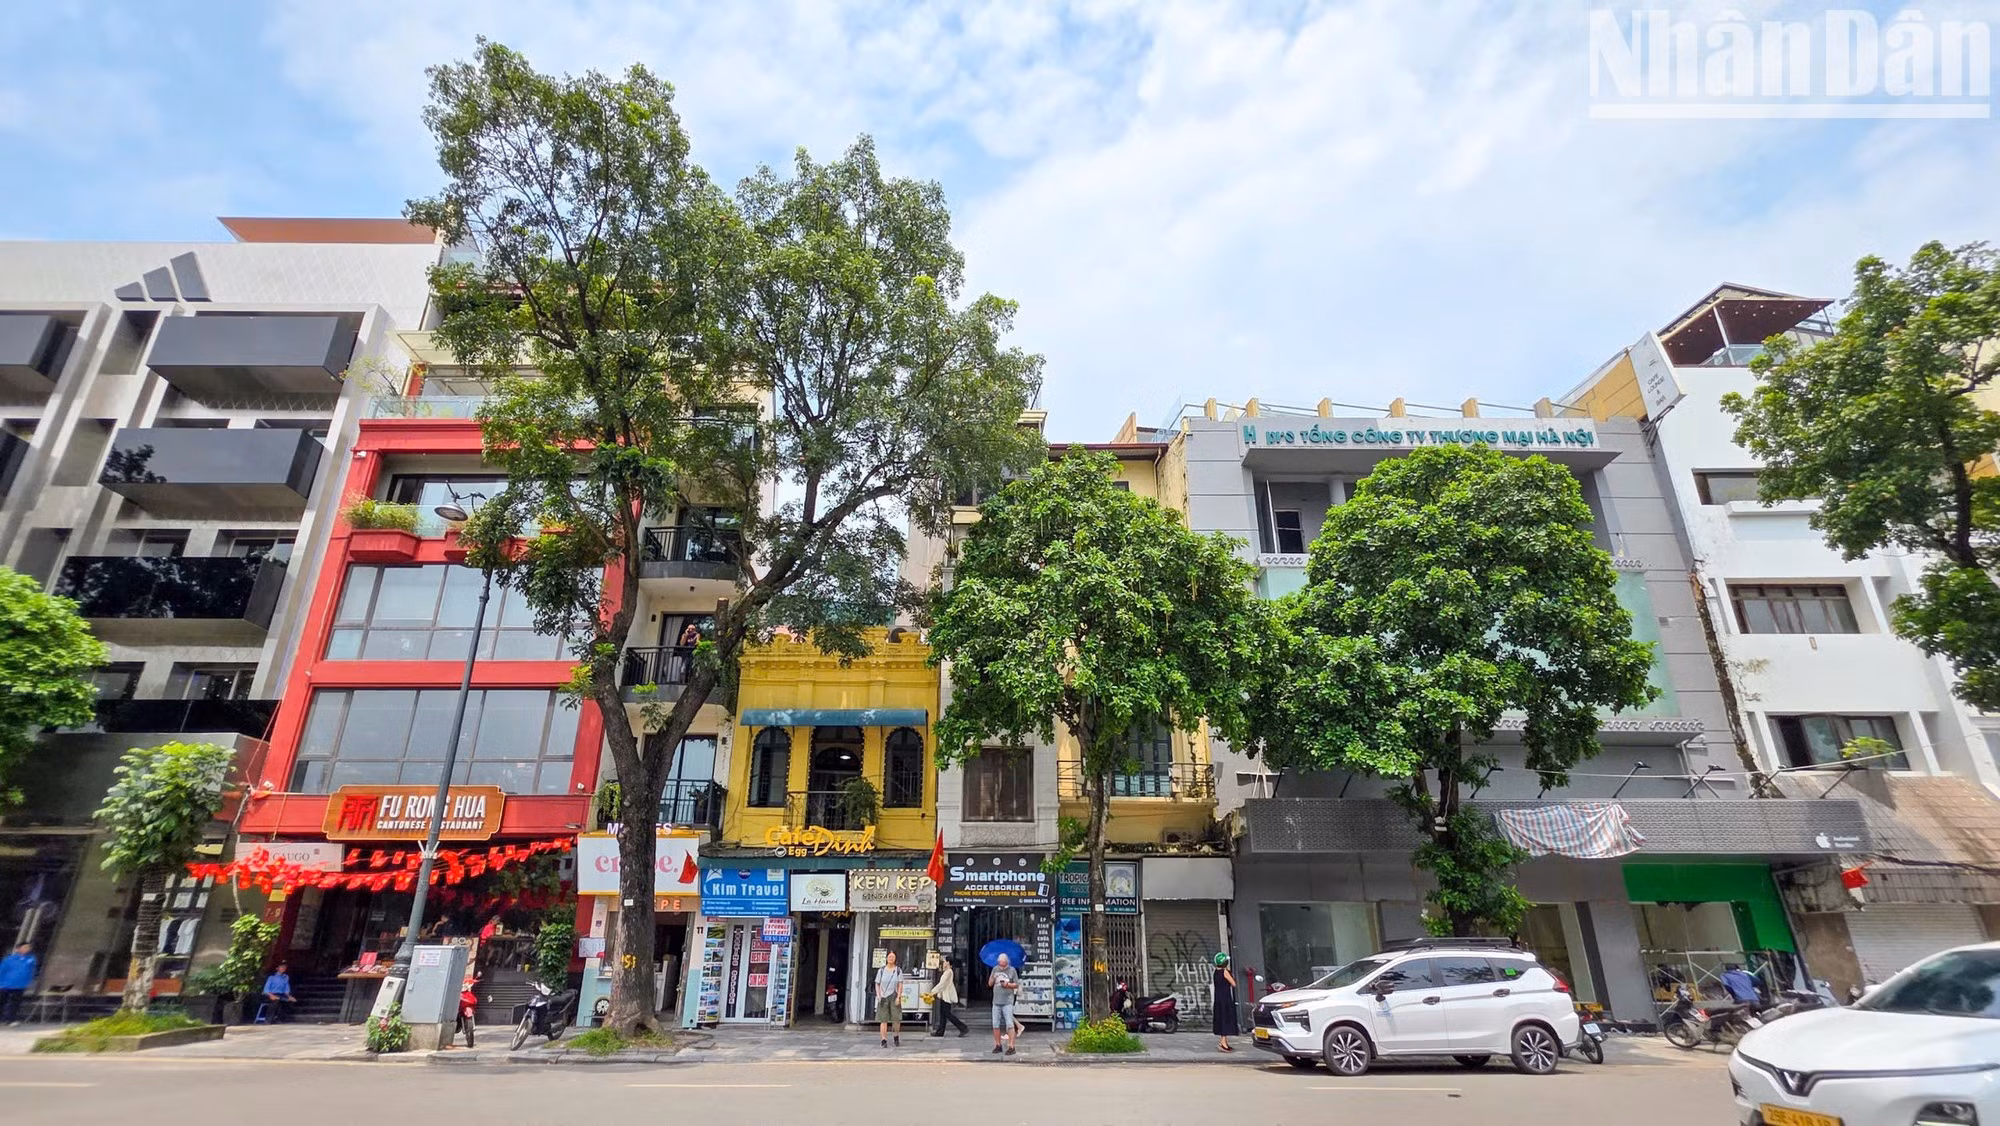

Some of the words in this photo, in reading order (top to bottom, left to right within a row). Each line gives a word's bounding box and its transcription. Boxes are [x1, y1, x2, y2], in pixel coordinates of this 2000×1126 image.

[1300, 424, 1348, 443] TỔNG
[1351, 427, 1403, 443] CÔNG
[1406, 430, 1427, 444] TY
[1429, 429, 1500, 443] THƯƠNG
[1502, 431, 1534, 446] MẠI
[1536, 427, 1562, 443] HÀ
[1562, 428, 1594, 447] NỘI
[379, 795, 401, 818] FU
[453, 795, 486, 818] HUA
[376, 821, 427, 829] CANTONESE
[428, 821, 484, 830] STAURANT
[788, 846, 808, 857] Egg
[950, 866, 1046, 884] Smartphone
[741, 883, 785, 896] Travel
[853, 875, 889, 891] KEM
[895, 875, 932, 893] KẸP
[862, 892, 910, 901] SINGAPORE
